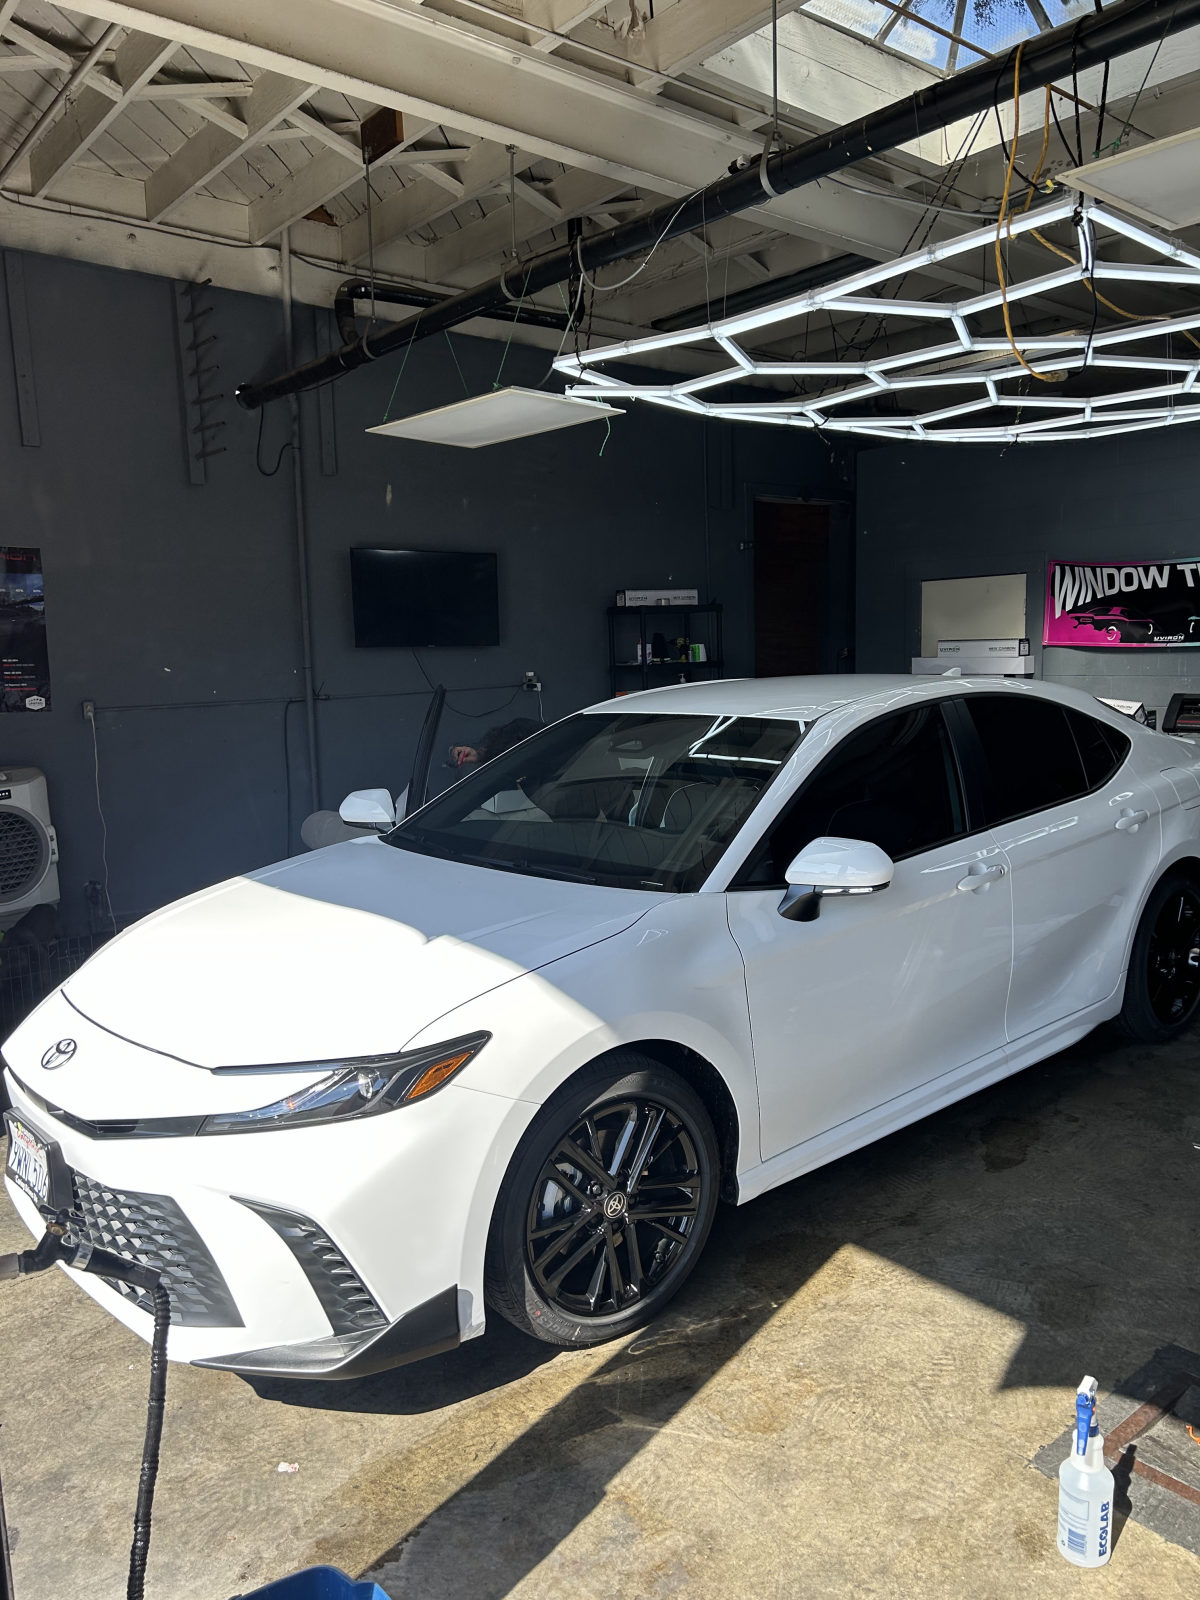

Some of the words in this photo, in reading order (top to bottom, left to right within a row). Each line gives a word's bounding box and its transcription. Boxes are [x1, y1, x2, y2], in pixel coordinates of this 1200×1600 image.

[1054, 565, 1170, 619] WINDOW
[1153, 634, 1185, 642] UVIRON
[1098, 1501, 1110, 1558] ECOLAB
